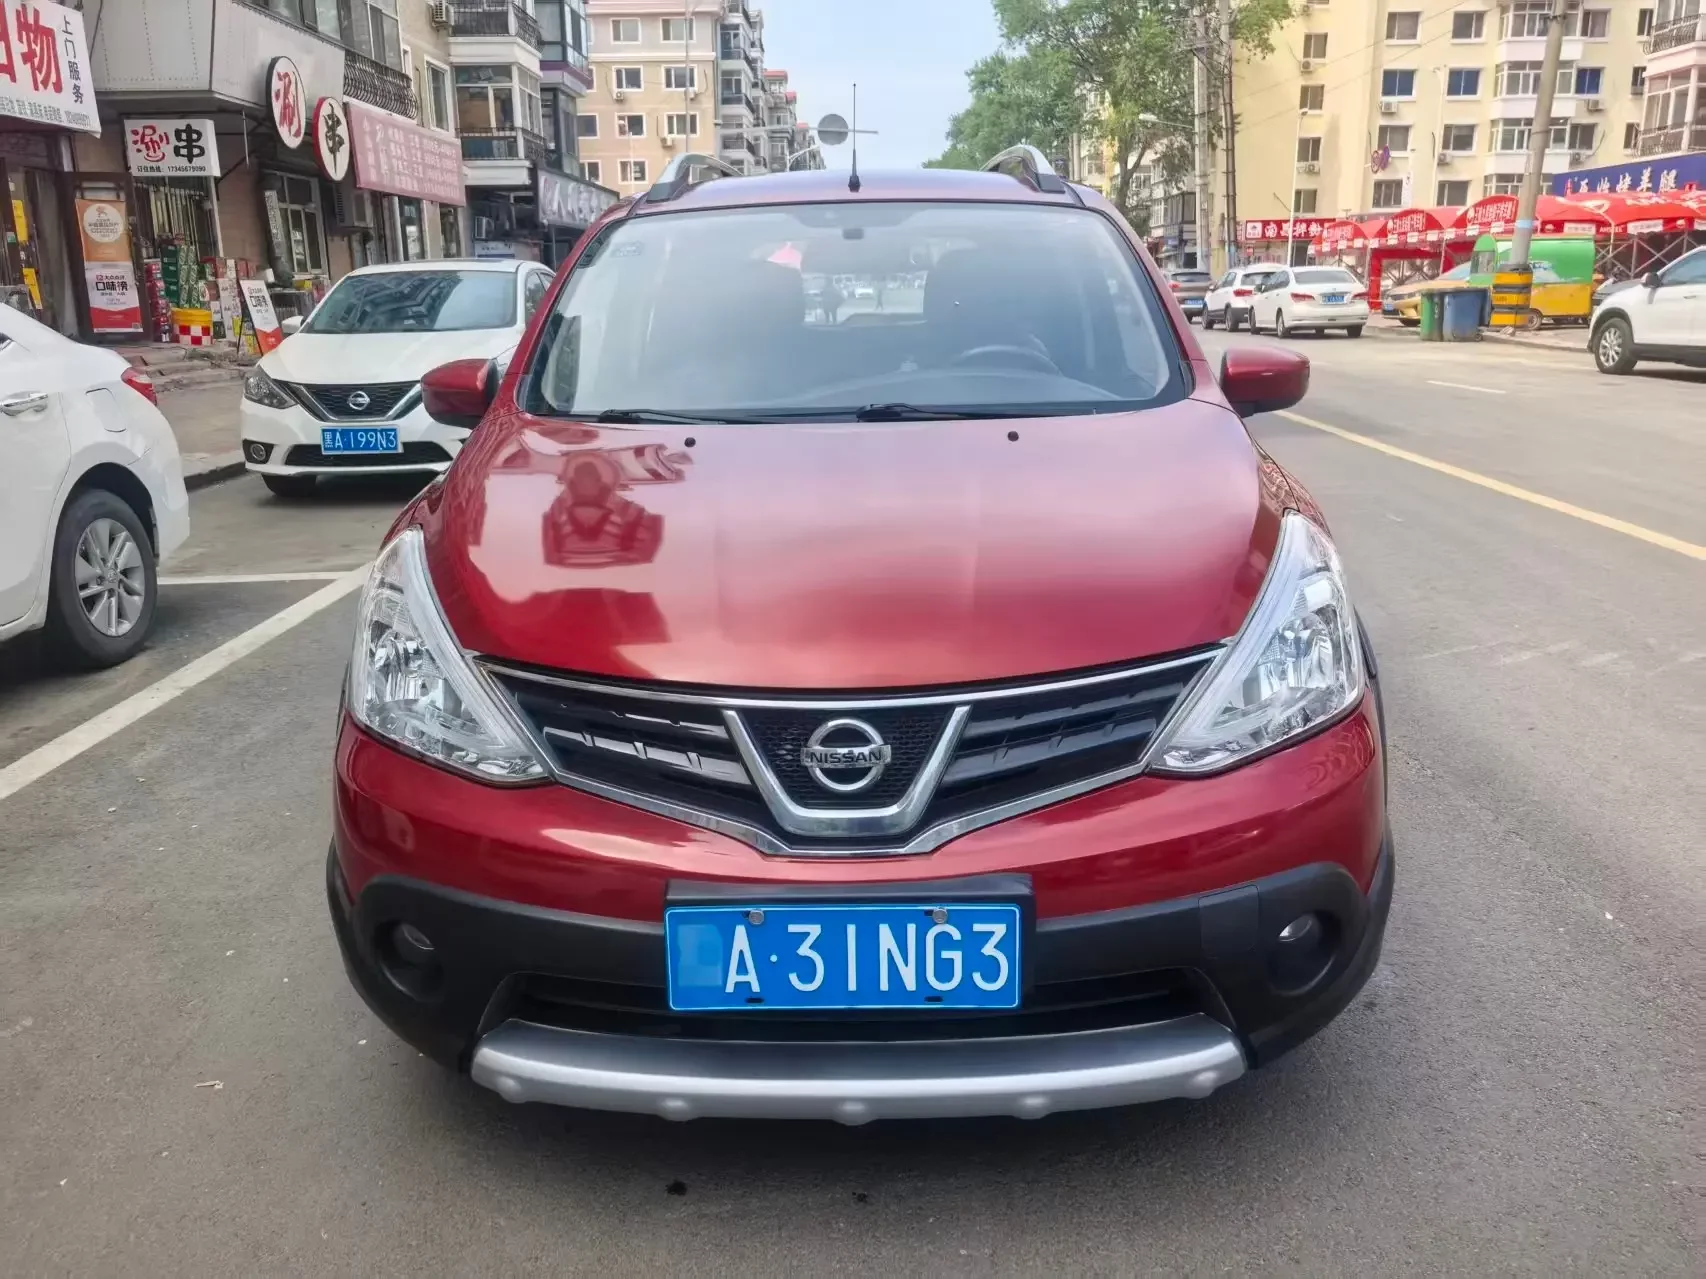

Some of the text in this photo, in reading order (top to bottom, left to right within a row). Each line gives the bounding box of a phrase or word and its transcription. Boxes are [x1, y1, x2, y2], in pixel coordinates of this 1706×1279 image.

[62, 15, 83, 104] 上门服务
[810, 751, 881, 763] NISSAN
